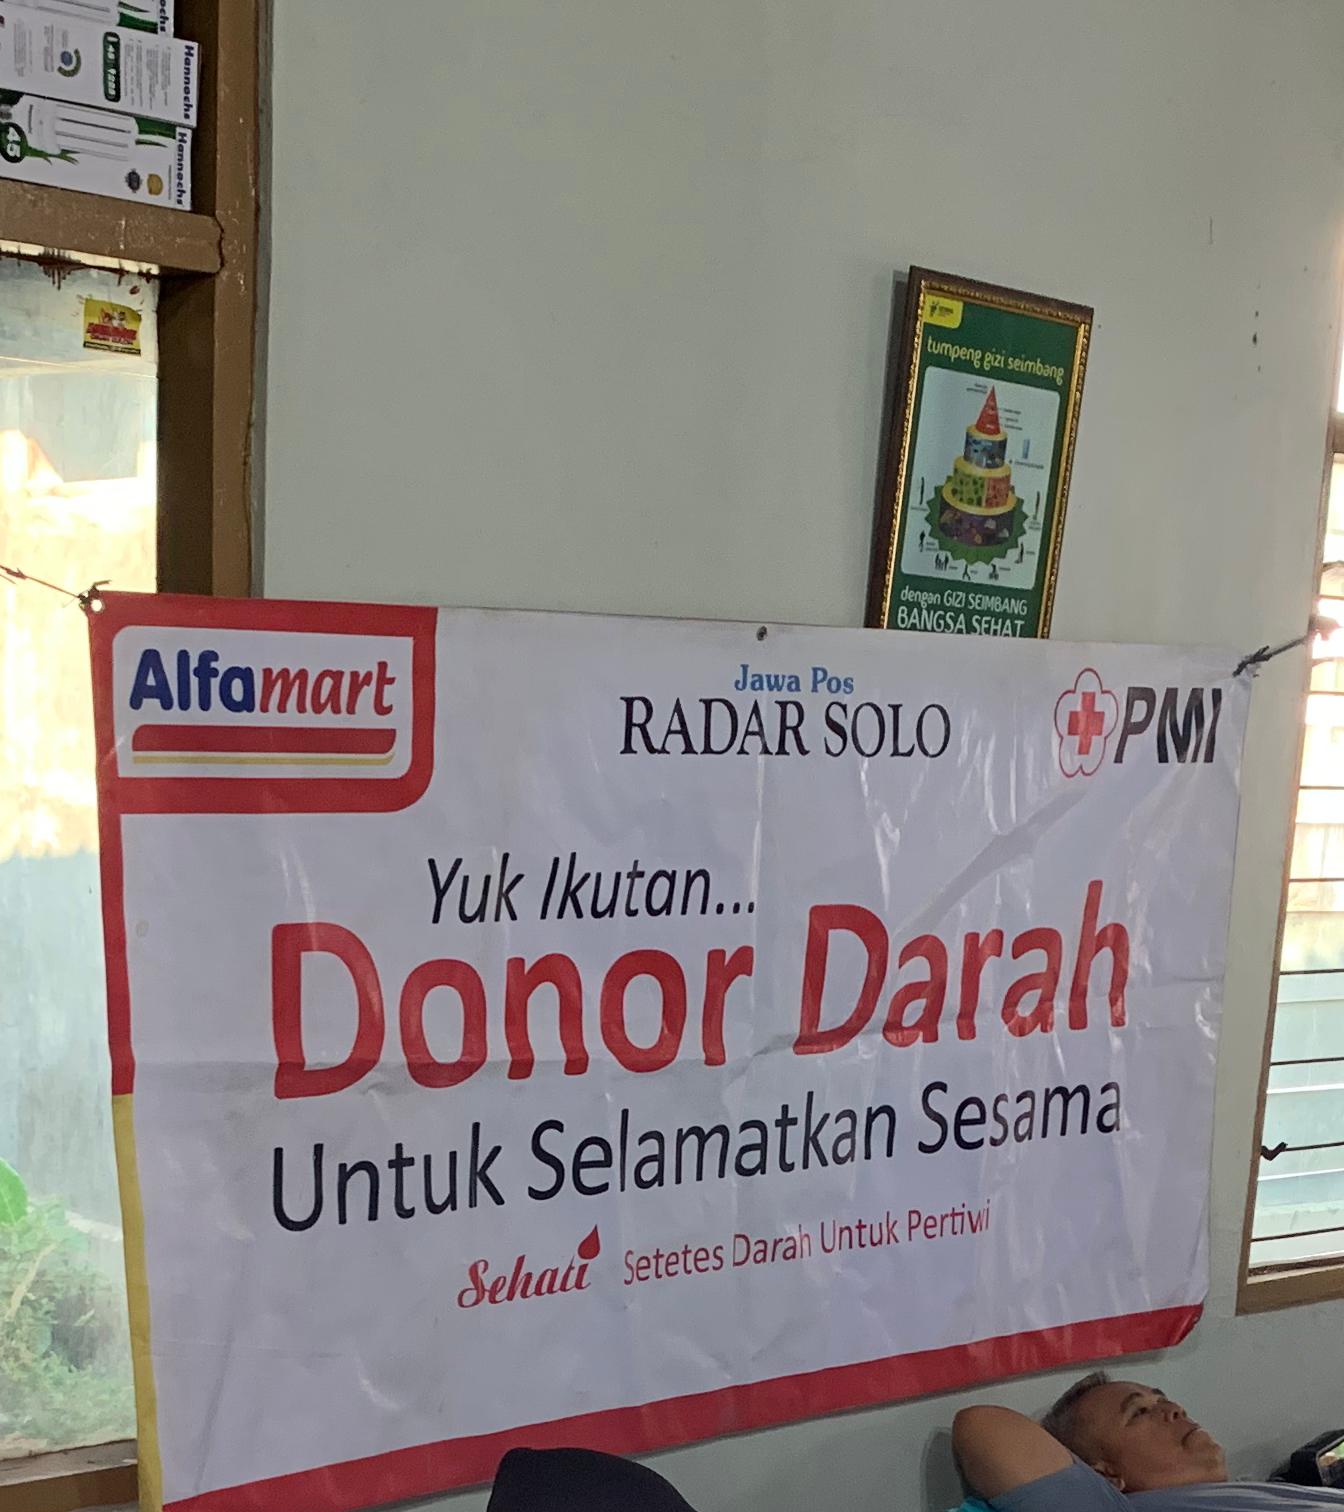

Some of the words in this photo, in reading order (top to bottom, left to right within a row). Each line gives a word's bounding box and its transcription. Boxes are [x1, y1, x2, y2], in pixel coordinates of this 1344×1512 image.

[183, 44, 195, 121] Hannochs
[176, 131, 188, 206] Hannochs
[927, 336, 982, 368] tumpeng
[984, 348, 1005, 371] gizi
[1008, 354, 1065, 386] seimbang
[897, 605, 967, 635] BANGSA
[970, 614, 1026, 638] SEHAT
[900, 585, 942, 609] dengan
[943, 589, 966, 608] GIZI
[967, 592, 1028, 616] SEIMBANG
[129, 648, 397, 717] Alfamart
[734, 663, 799, 694] Jawa
[804, 667, 854, 696] Pos
[620, 696, 809, 758] RADAR
[824, 701, 951, 760] SOLO
[1114, 686, 1223, 764] PMI
[428, 852, 524, 926] Yuk
[540, 850, 757, 921] Ikutan...
[271, 920, 755, 1100] Donor
[792, 878, 1130, 1057] Darah
[272, 1120, 505, 1232] Untuk
[528, 1092, 897, 1202] Selamatkan
[918, 1078, 1122, 1155] Sesama
[457, 1224, 601, 1308] Sehati
[623, 1241, 724, 1286] Setetes
[732, 1226, 812, 1268] Darah
[820, 1210, 899, 1254] Untuk
[908, 1199, 991, 1242] Pertiwi
